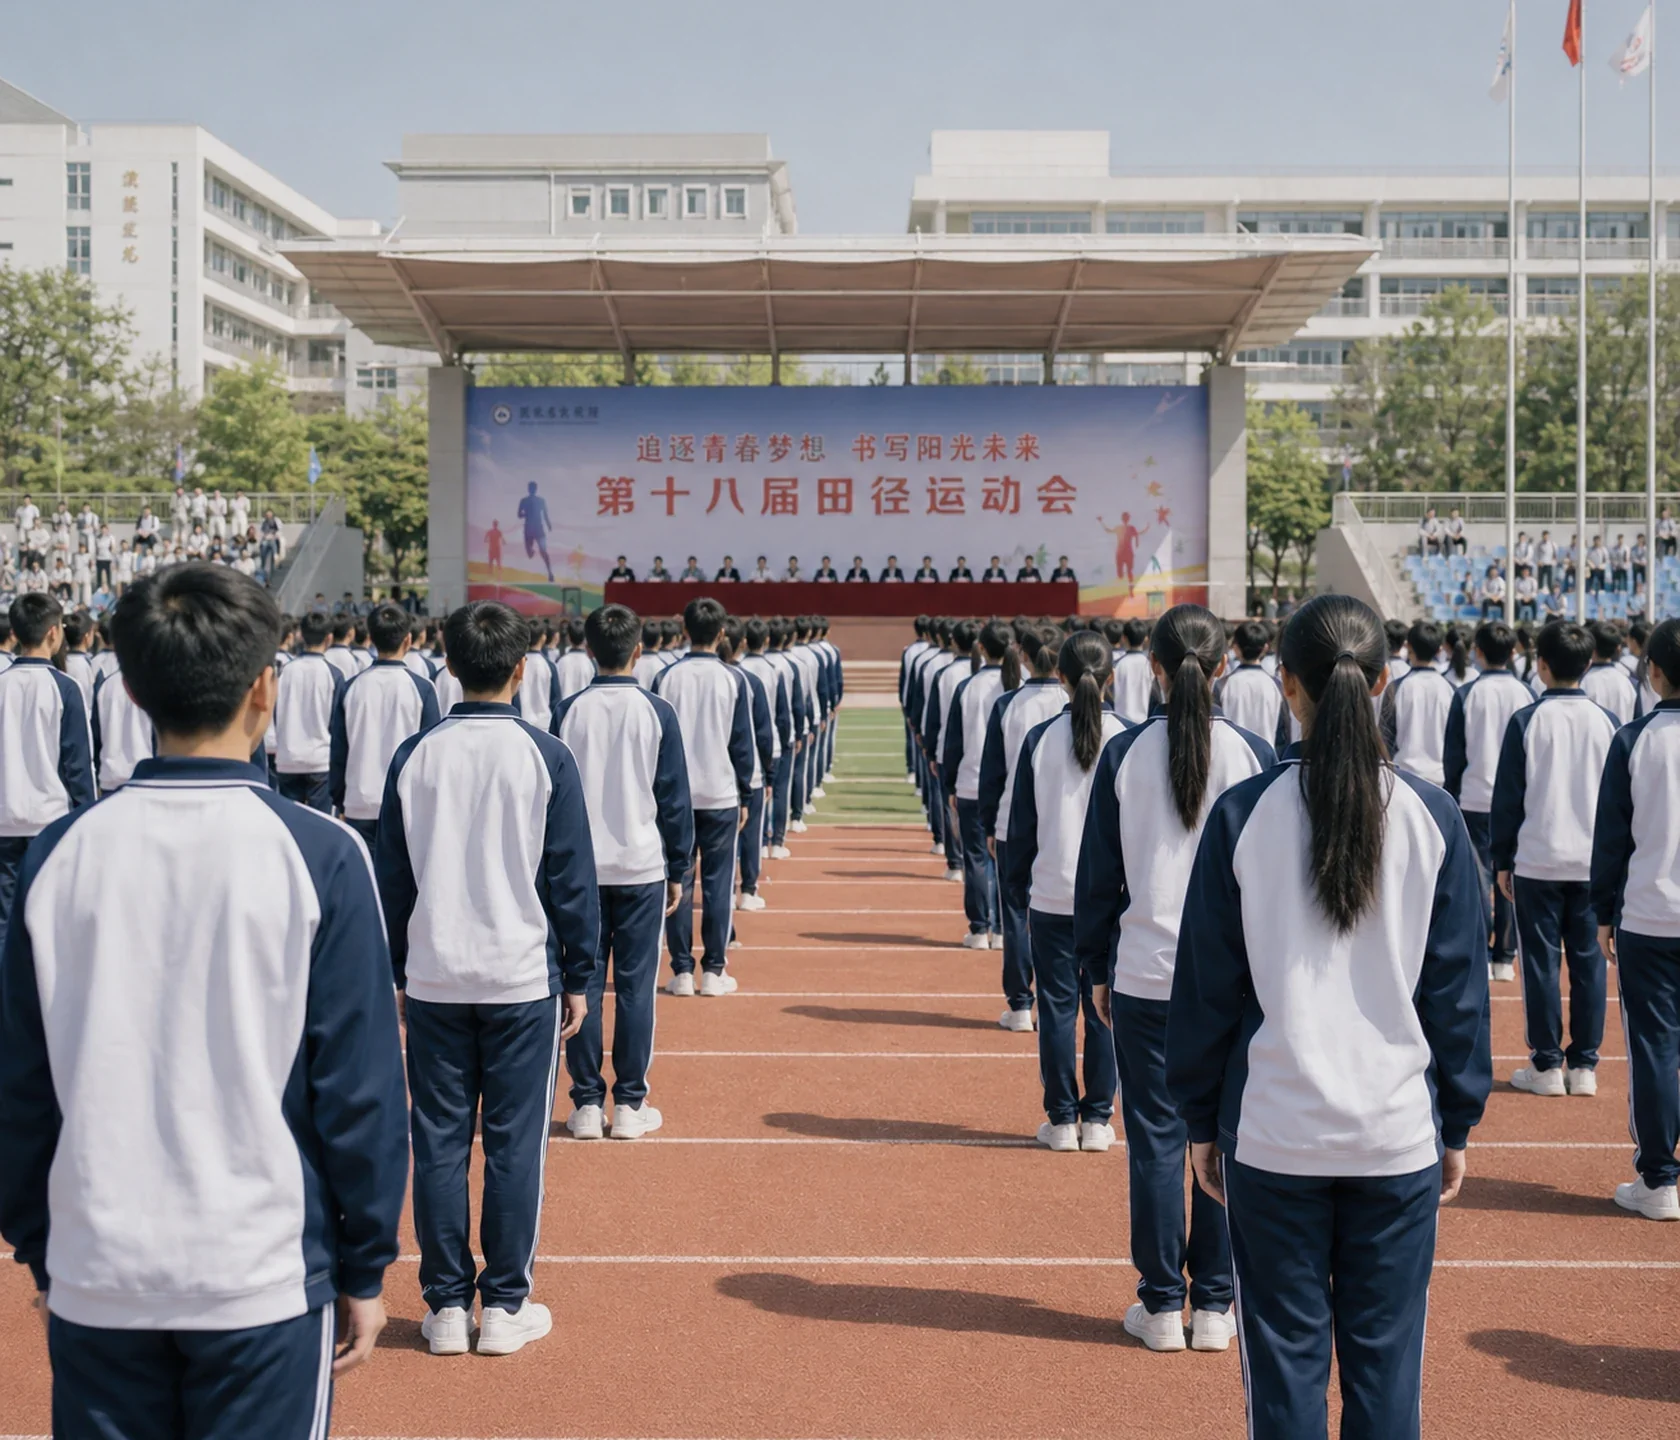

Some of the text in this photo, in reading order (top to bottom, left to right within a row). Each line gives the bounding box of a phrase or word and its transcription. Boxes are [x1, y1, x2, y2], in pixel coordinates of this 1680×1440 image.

[637, 433, 1040, 463] 追逐青春梦想 书写阳光未来
[596, 474, 1077, 516] 第十八届田径运动会
